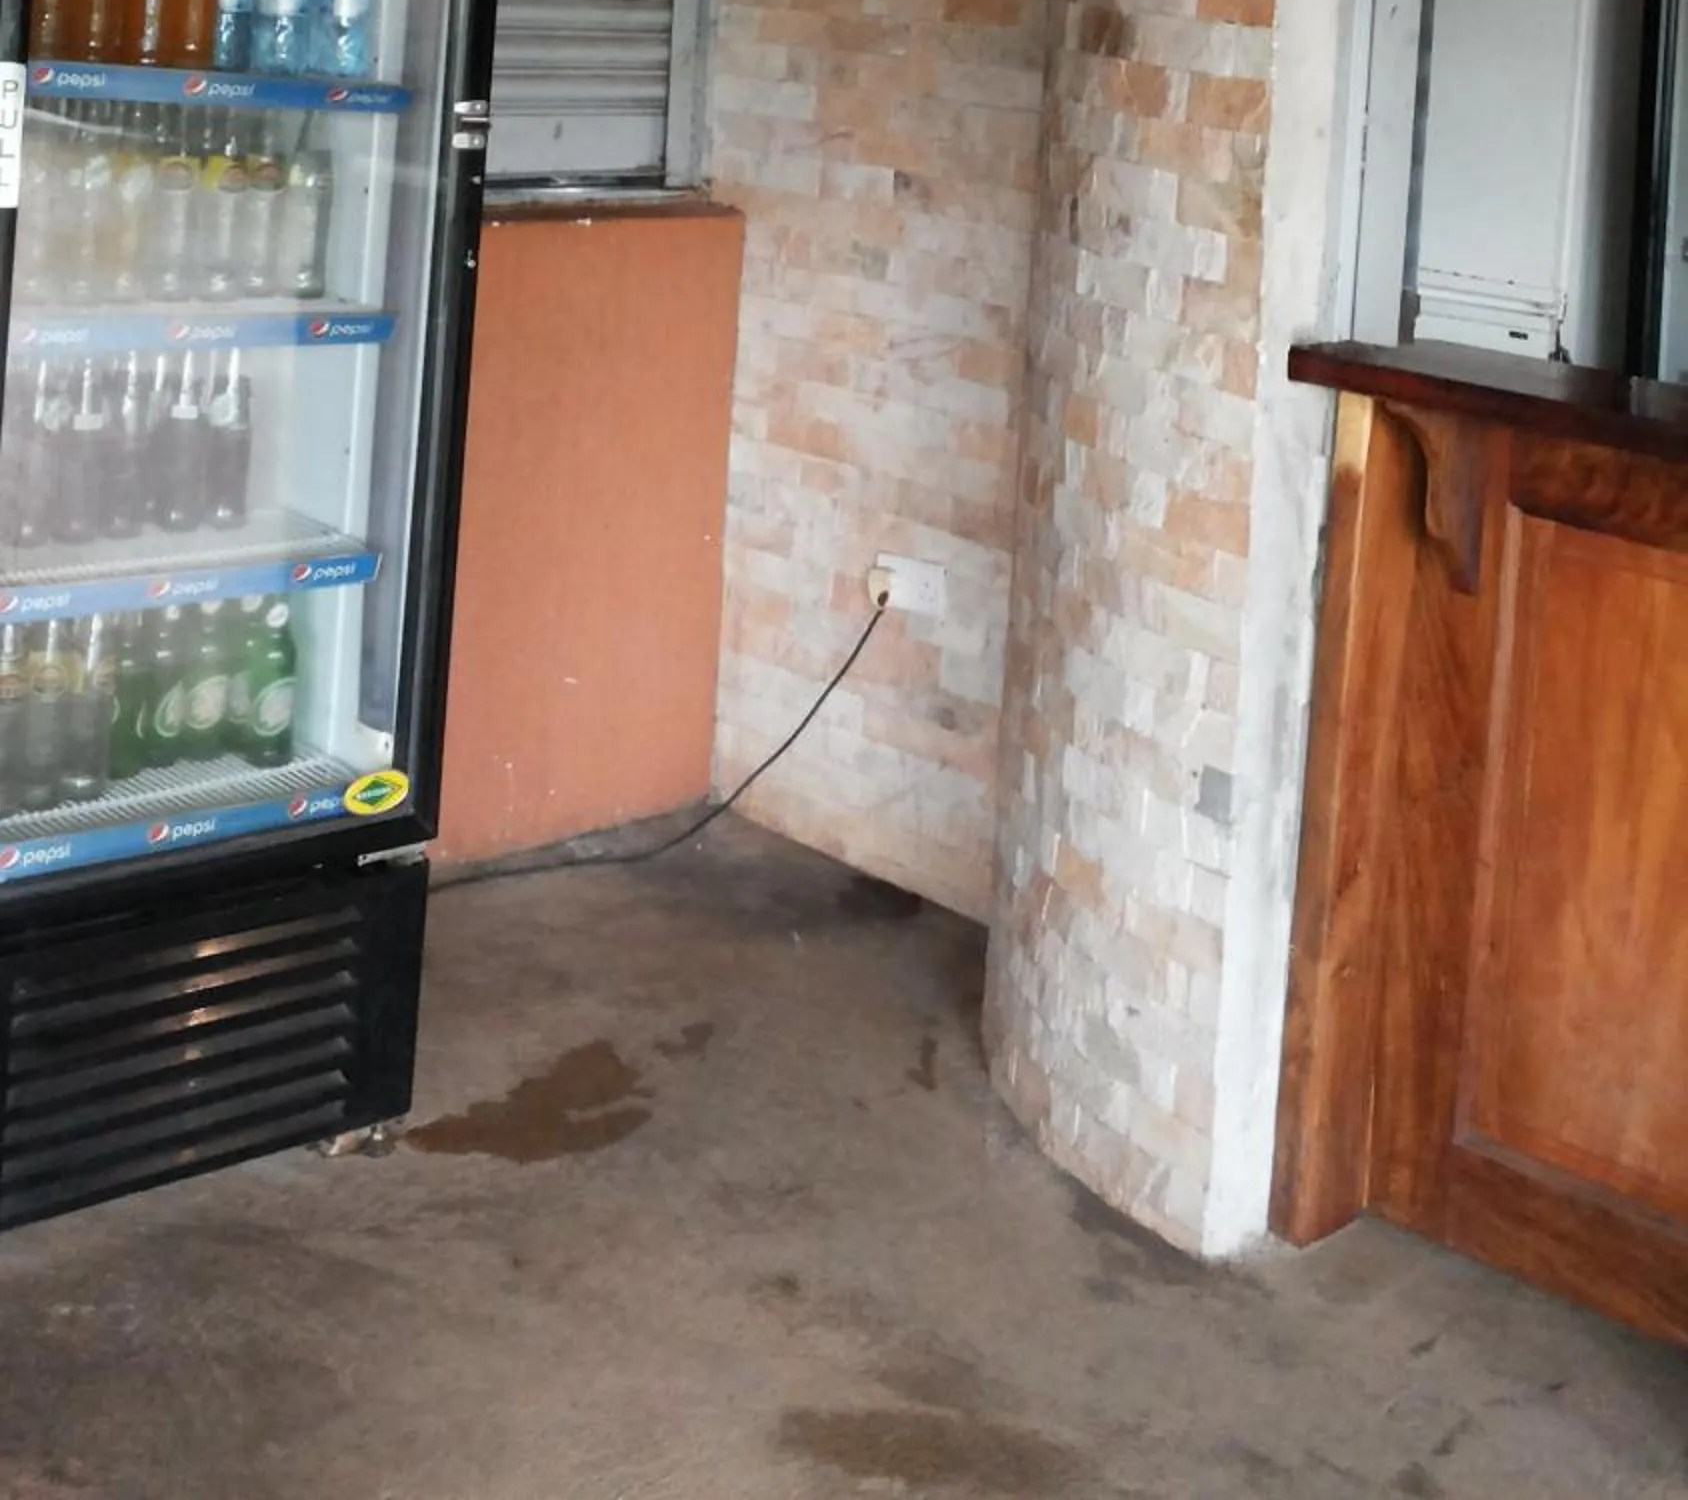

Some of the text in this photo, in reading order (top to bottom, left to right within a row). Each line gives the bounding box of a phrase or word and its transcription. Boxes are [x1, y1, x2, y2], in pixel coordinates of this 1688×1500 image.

[57, 72, 105, 89] pepsi
[208, 82, 255, 98] pepsi
[40, 326, 88, 345] pepsi
[313, 562, 356, 581] pepsi
[171, 578, 219, 597] pepsi
[21, 593, 71, 613] pepsi
[309, 795, 341, 814] pep
[172, 818, 216, 841] pepsi
[22, 844, 71, 867] pepsi
